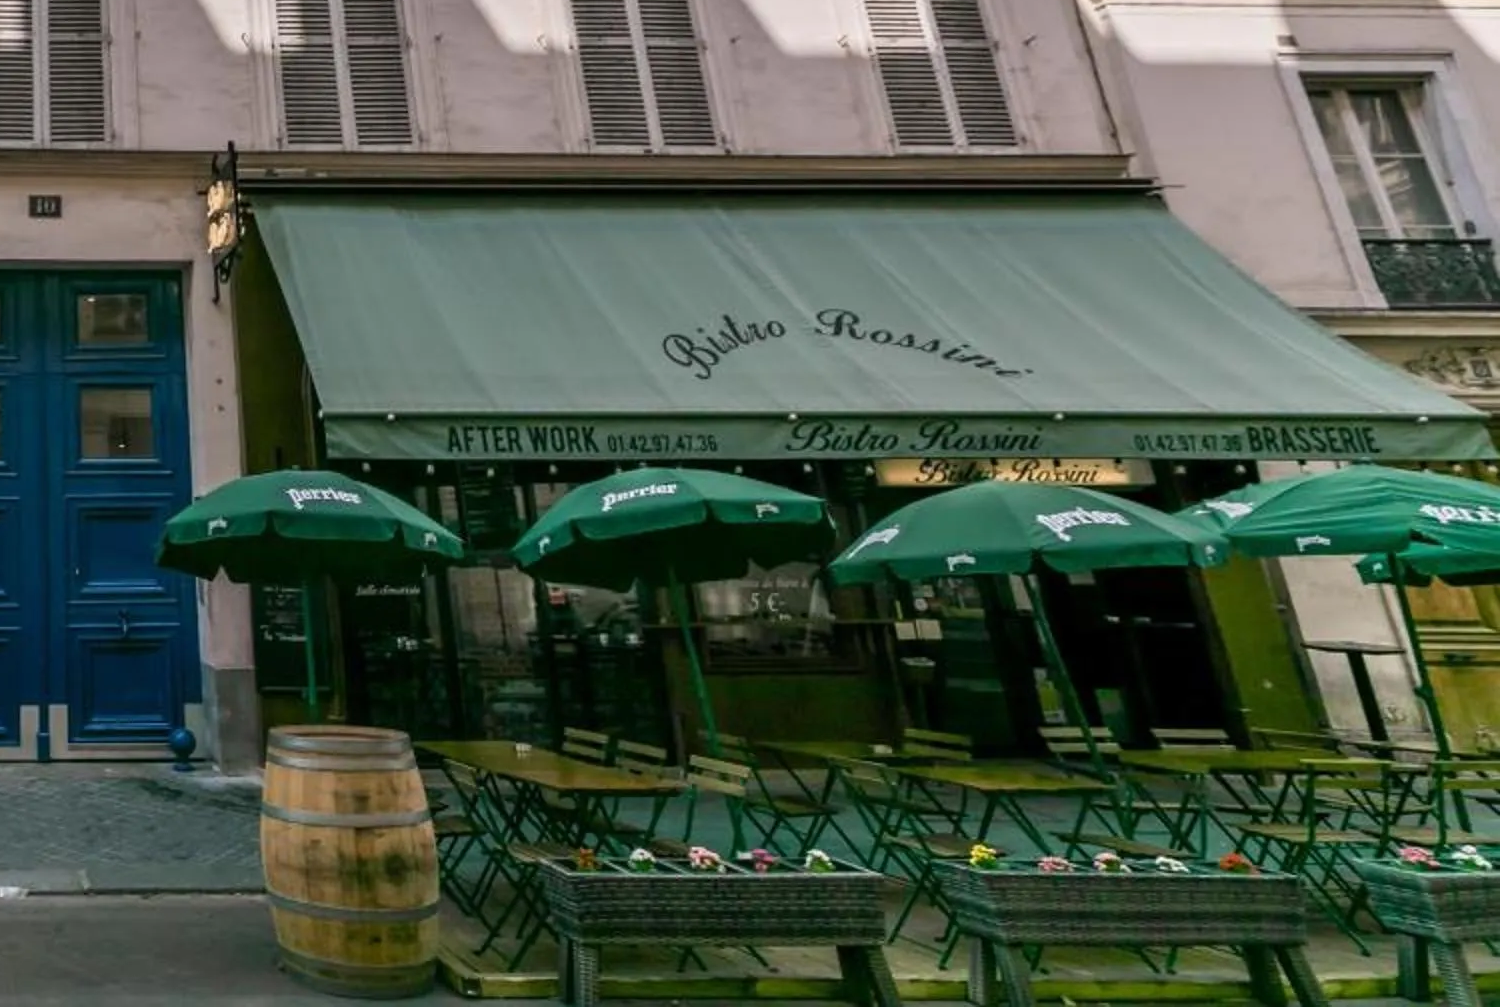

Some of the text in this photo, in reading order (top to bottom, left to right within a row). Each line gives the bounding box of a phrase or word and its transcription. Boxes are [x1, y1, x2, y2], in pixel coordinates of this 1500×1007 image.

[662, 308, 1034, 381] Bistro Rossini
[448, 426, 525, 454] AFTER
[528, 426, 599, 454] WORK
[785, 419, 1043, 453] Bistro Rossini
[1246, 425, 1382, 455] BRASSERIE
